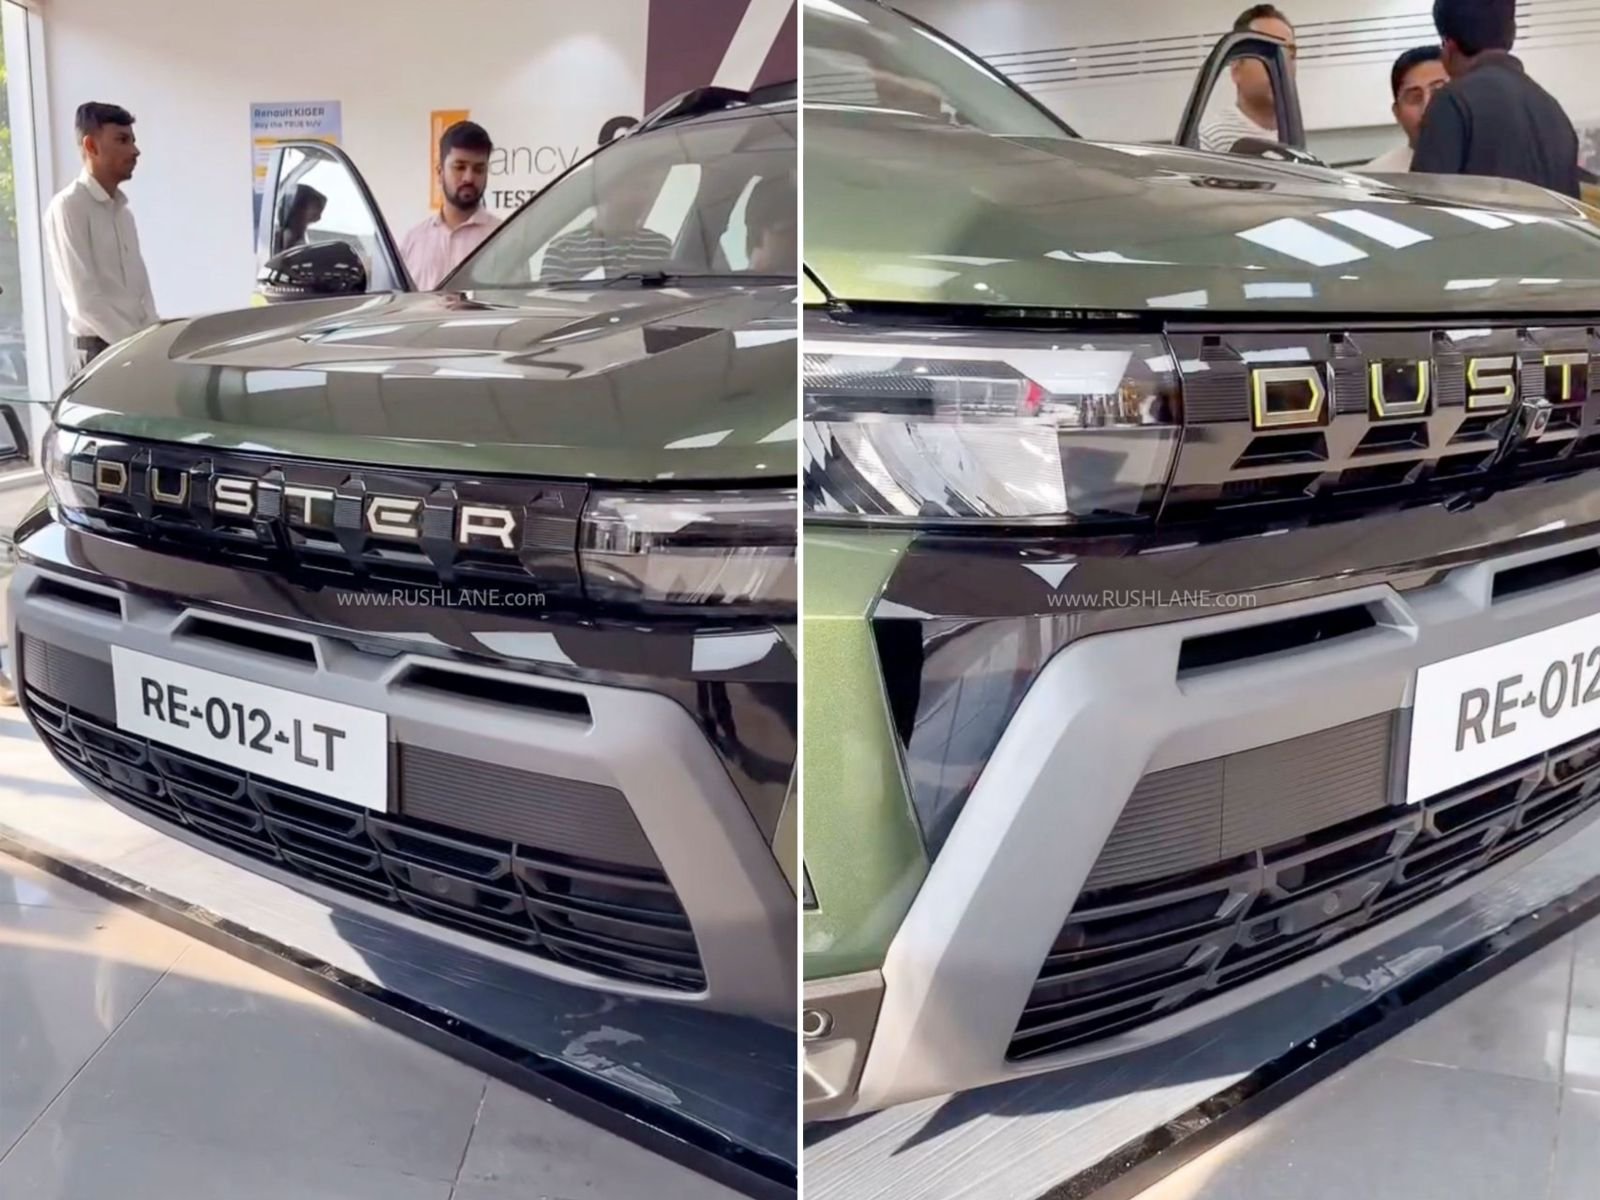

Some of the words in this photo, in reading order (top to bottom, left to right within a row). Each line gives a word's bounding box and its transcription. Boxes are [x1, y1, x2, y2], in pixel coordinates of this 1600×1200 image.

[254, 107, 293, 118] Renault
[294, 106, 325, 117] KIGER
[488, 146, 579, 176] ancy
[1252, 352, 1589, 428] DUST
[97, 461, 516, 549] DUSTER
